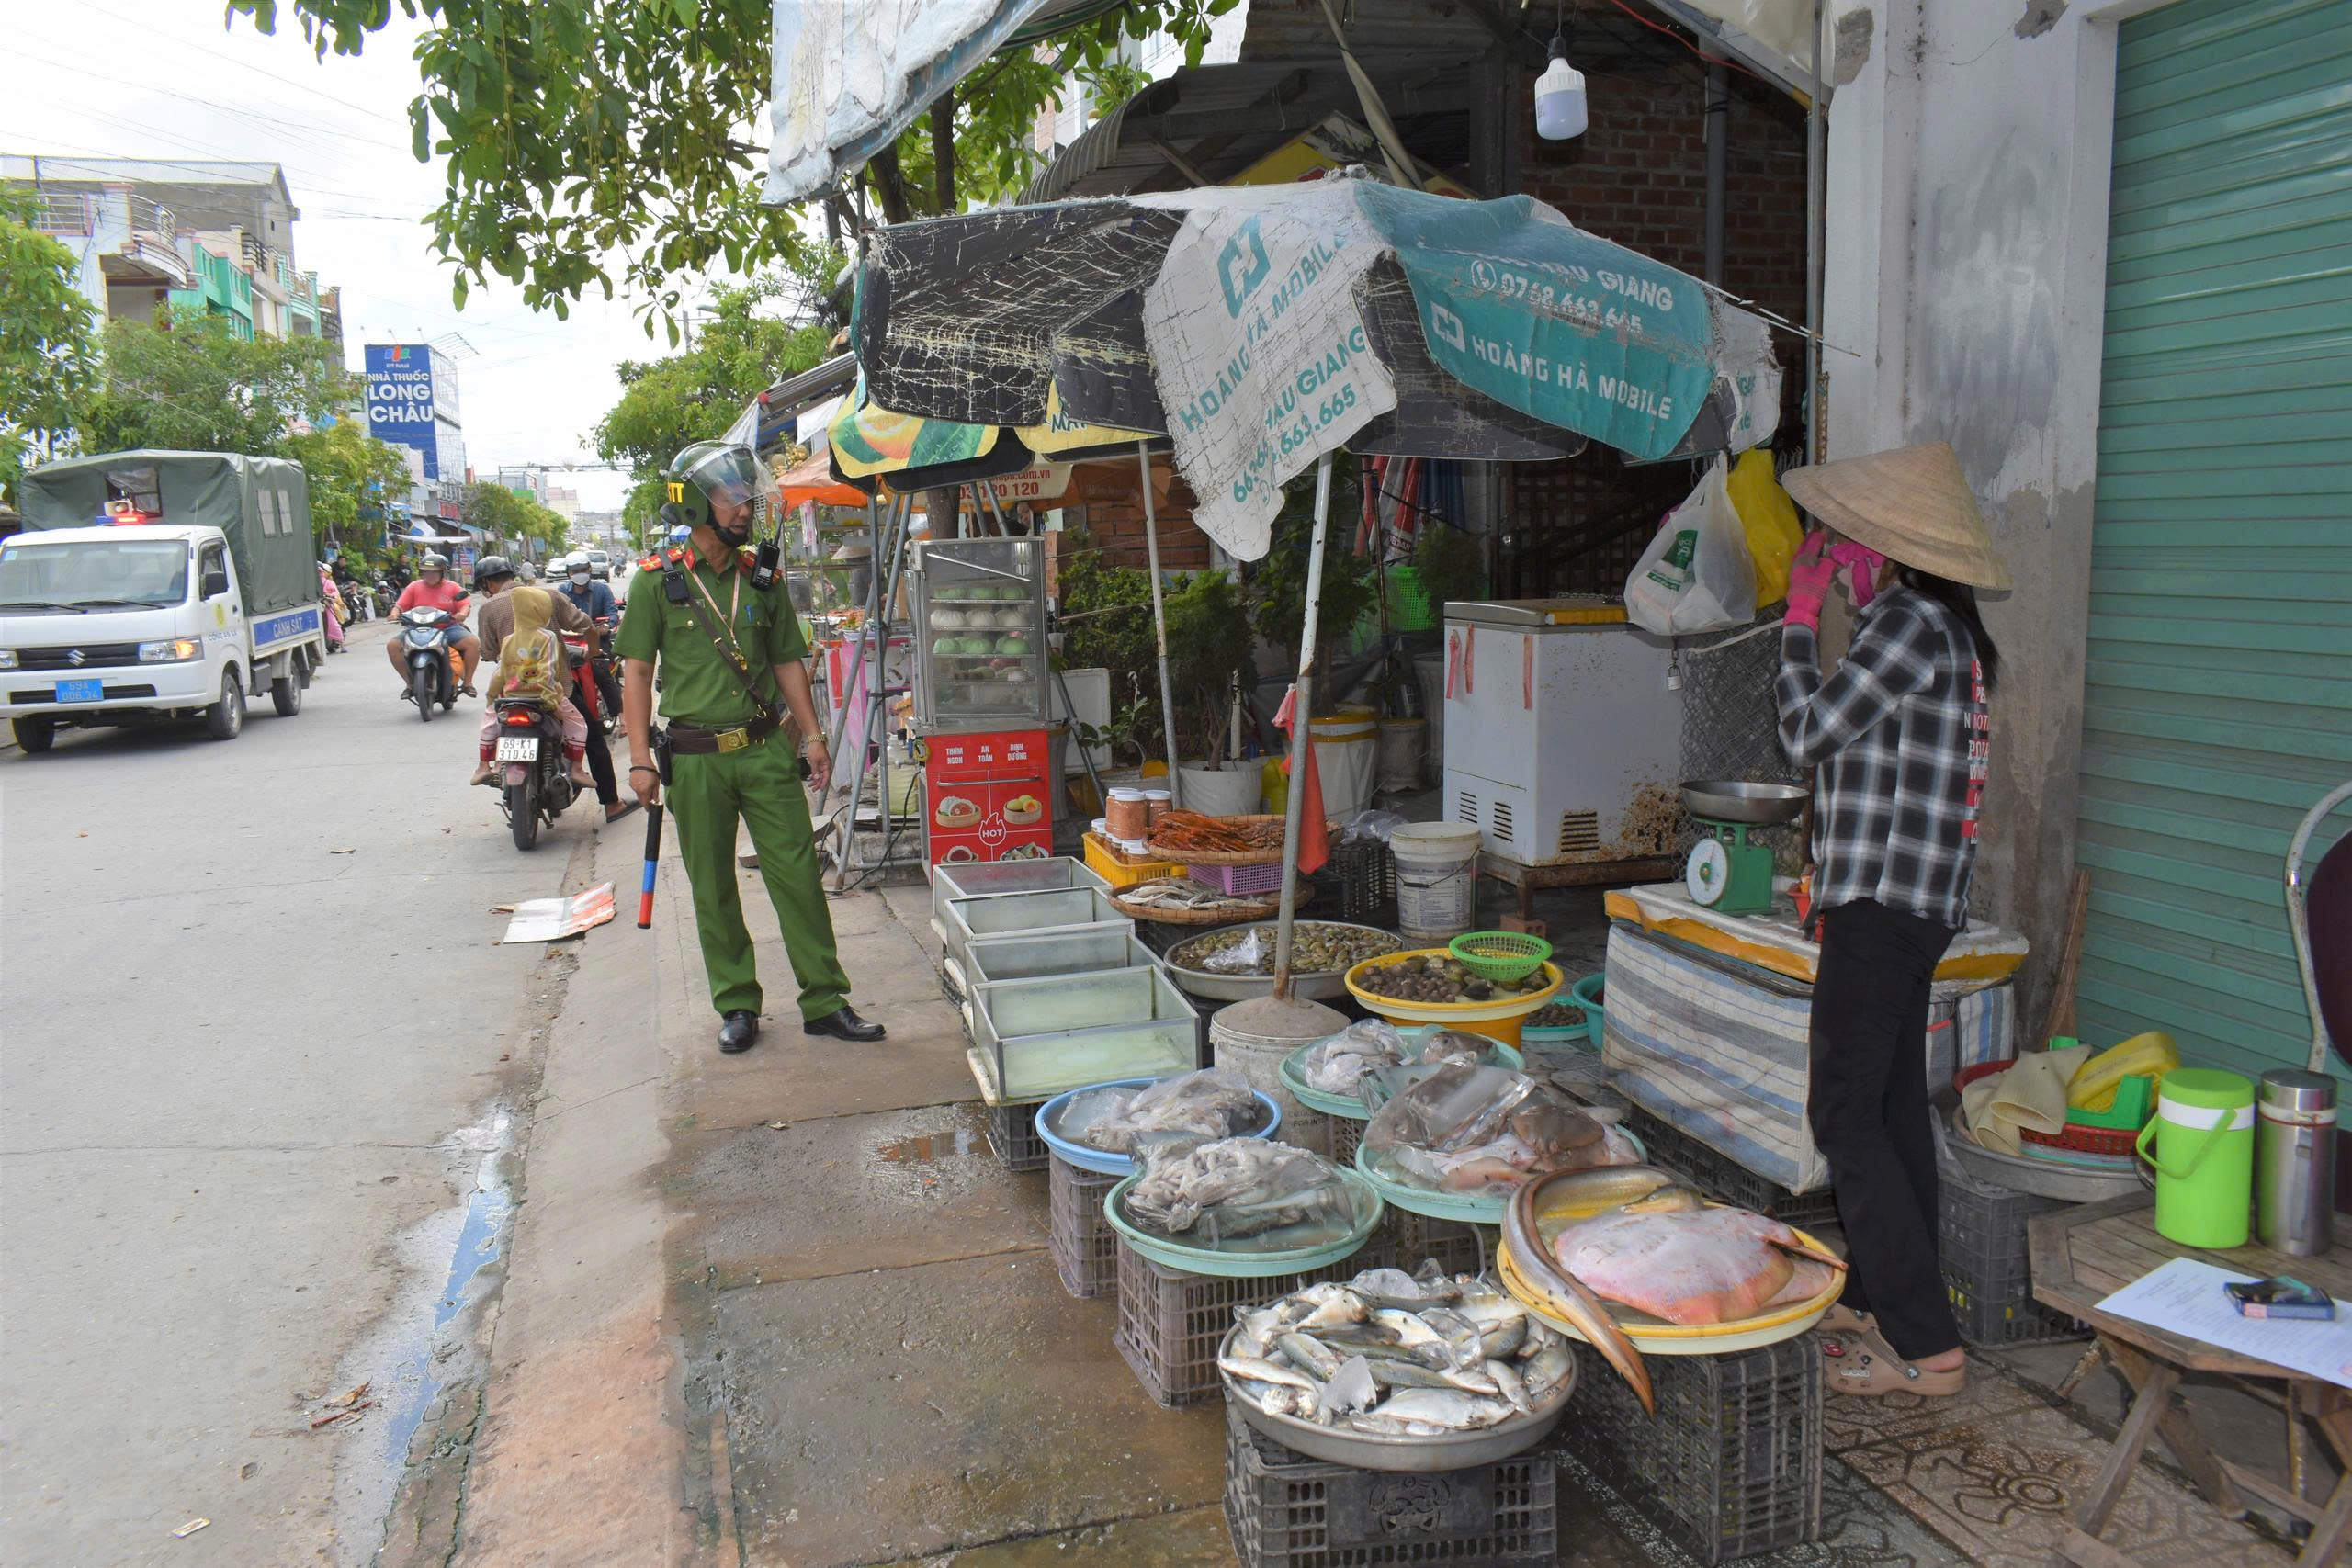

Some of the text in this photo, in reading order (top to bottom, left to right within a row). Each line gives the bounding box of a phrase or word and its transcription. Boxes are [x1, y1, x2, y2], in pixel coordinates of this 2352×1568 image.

[1596, 269, 1673, 311] GIANG
[1296, 325, 1367, 396] GIANG
[368, 369, 430, 381] NHÀ THUỐC
[1471, 333, 1672, 421] HOÀNG HÀ MOBILE
[369, 384, 431, 400] LONG
[370, 401, 434, 423] CHÂU
[1012, 482, 1039, 497] 120
[503, 739, 531, 749] 69-K1
[981, 745, 989, 753] AN
[499, 750, 536, 760] 310.46
[947, 756, 963, 764] NGON
[982, 829, 1003, 838] HOT
